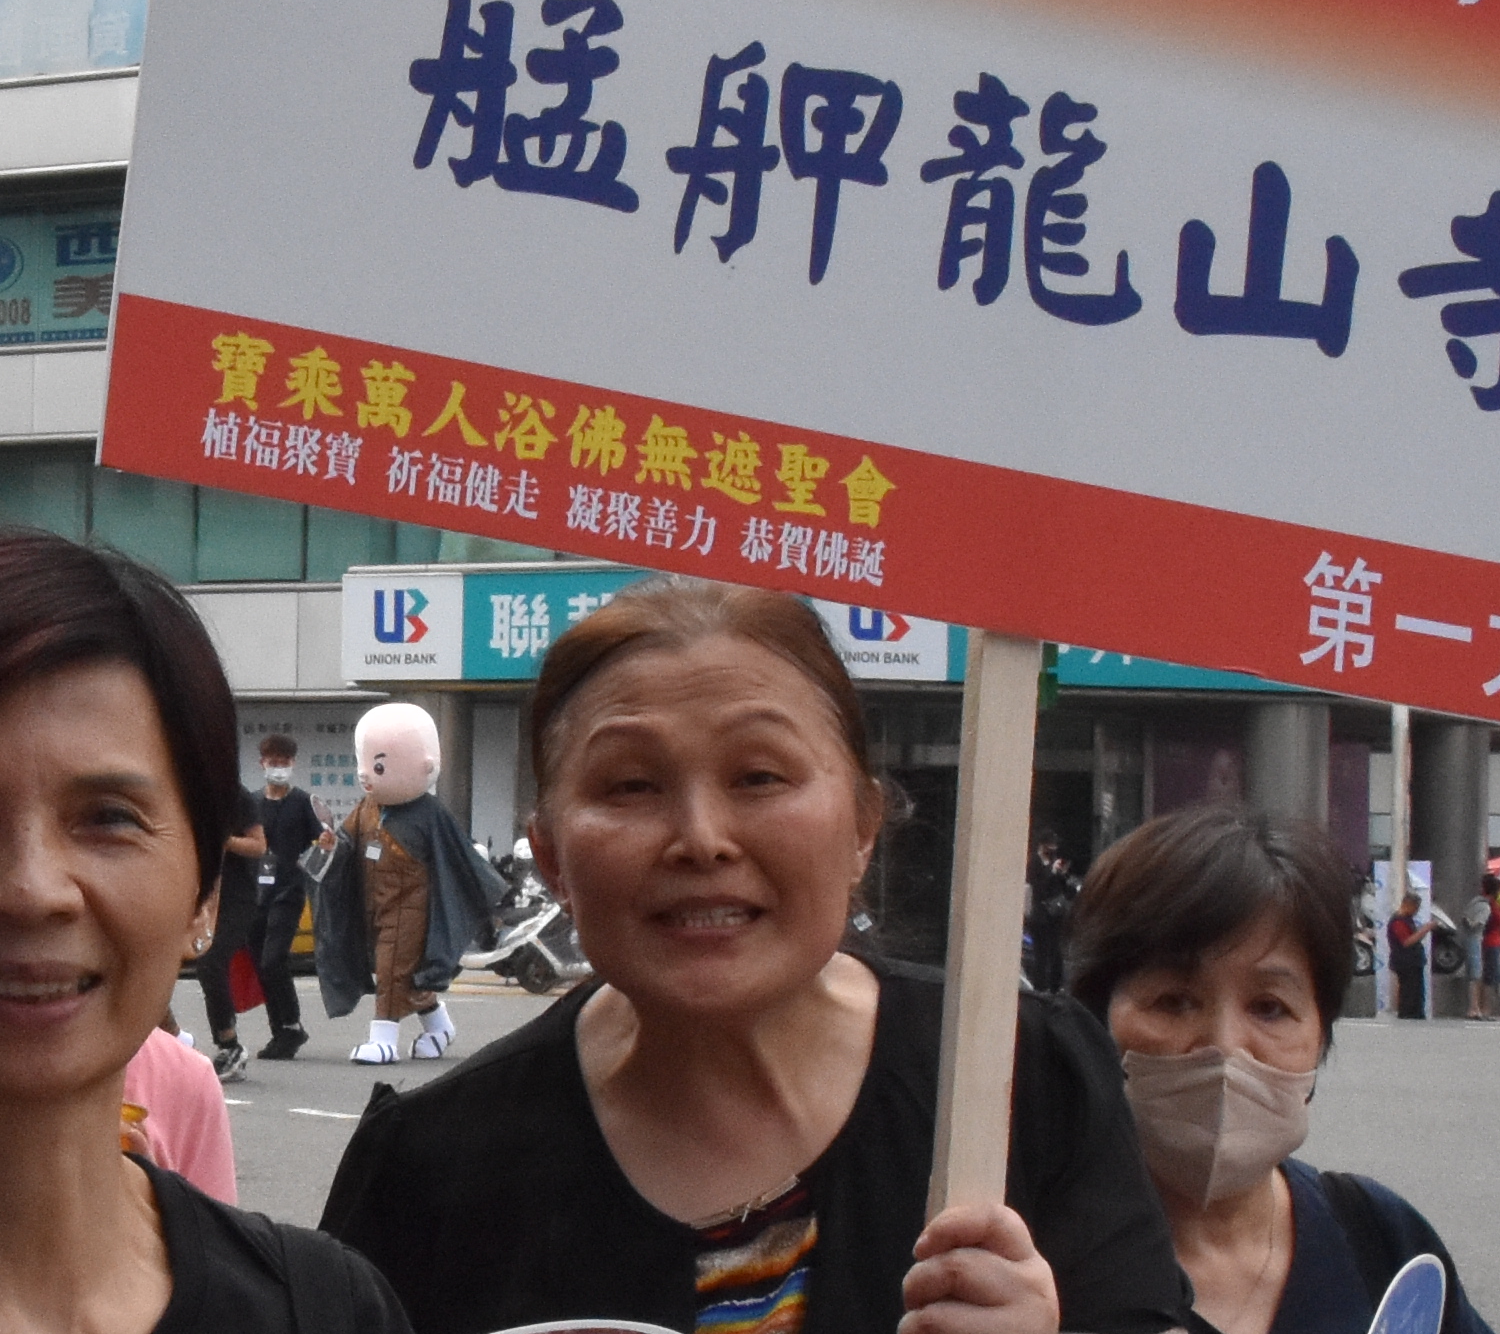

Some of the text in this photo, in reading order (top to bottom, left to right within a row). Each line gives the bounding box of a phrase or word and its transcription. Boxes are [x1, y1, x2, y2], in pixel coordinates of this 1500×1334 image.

[209, 329, 901, 530] 寶乘萬人浴佛無遮聖會
[201, 406, 886, 589] 植福聚寶 祈福健走 凝聚善力 恭賀佛誕
[364, 653, 438, 666] UNION BANK
[880, 651, 921, 666] BANK
